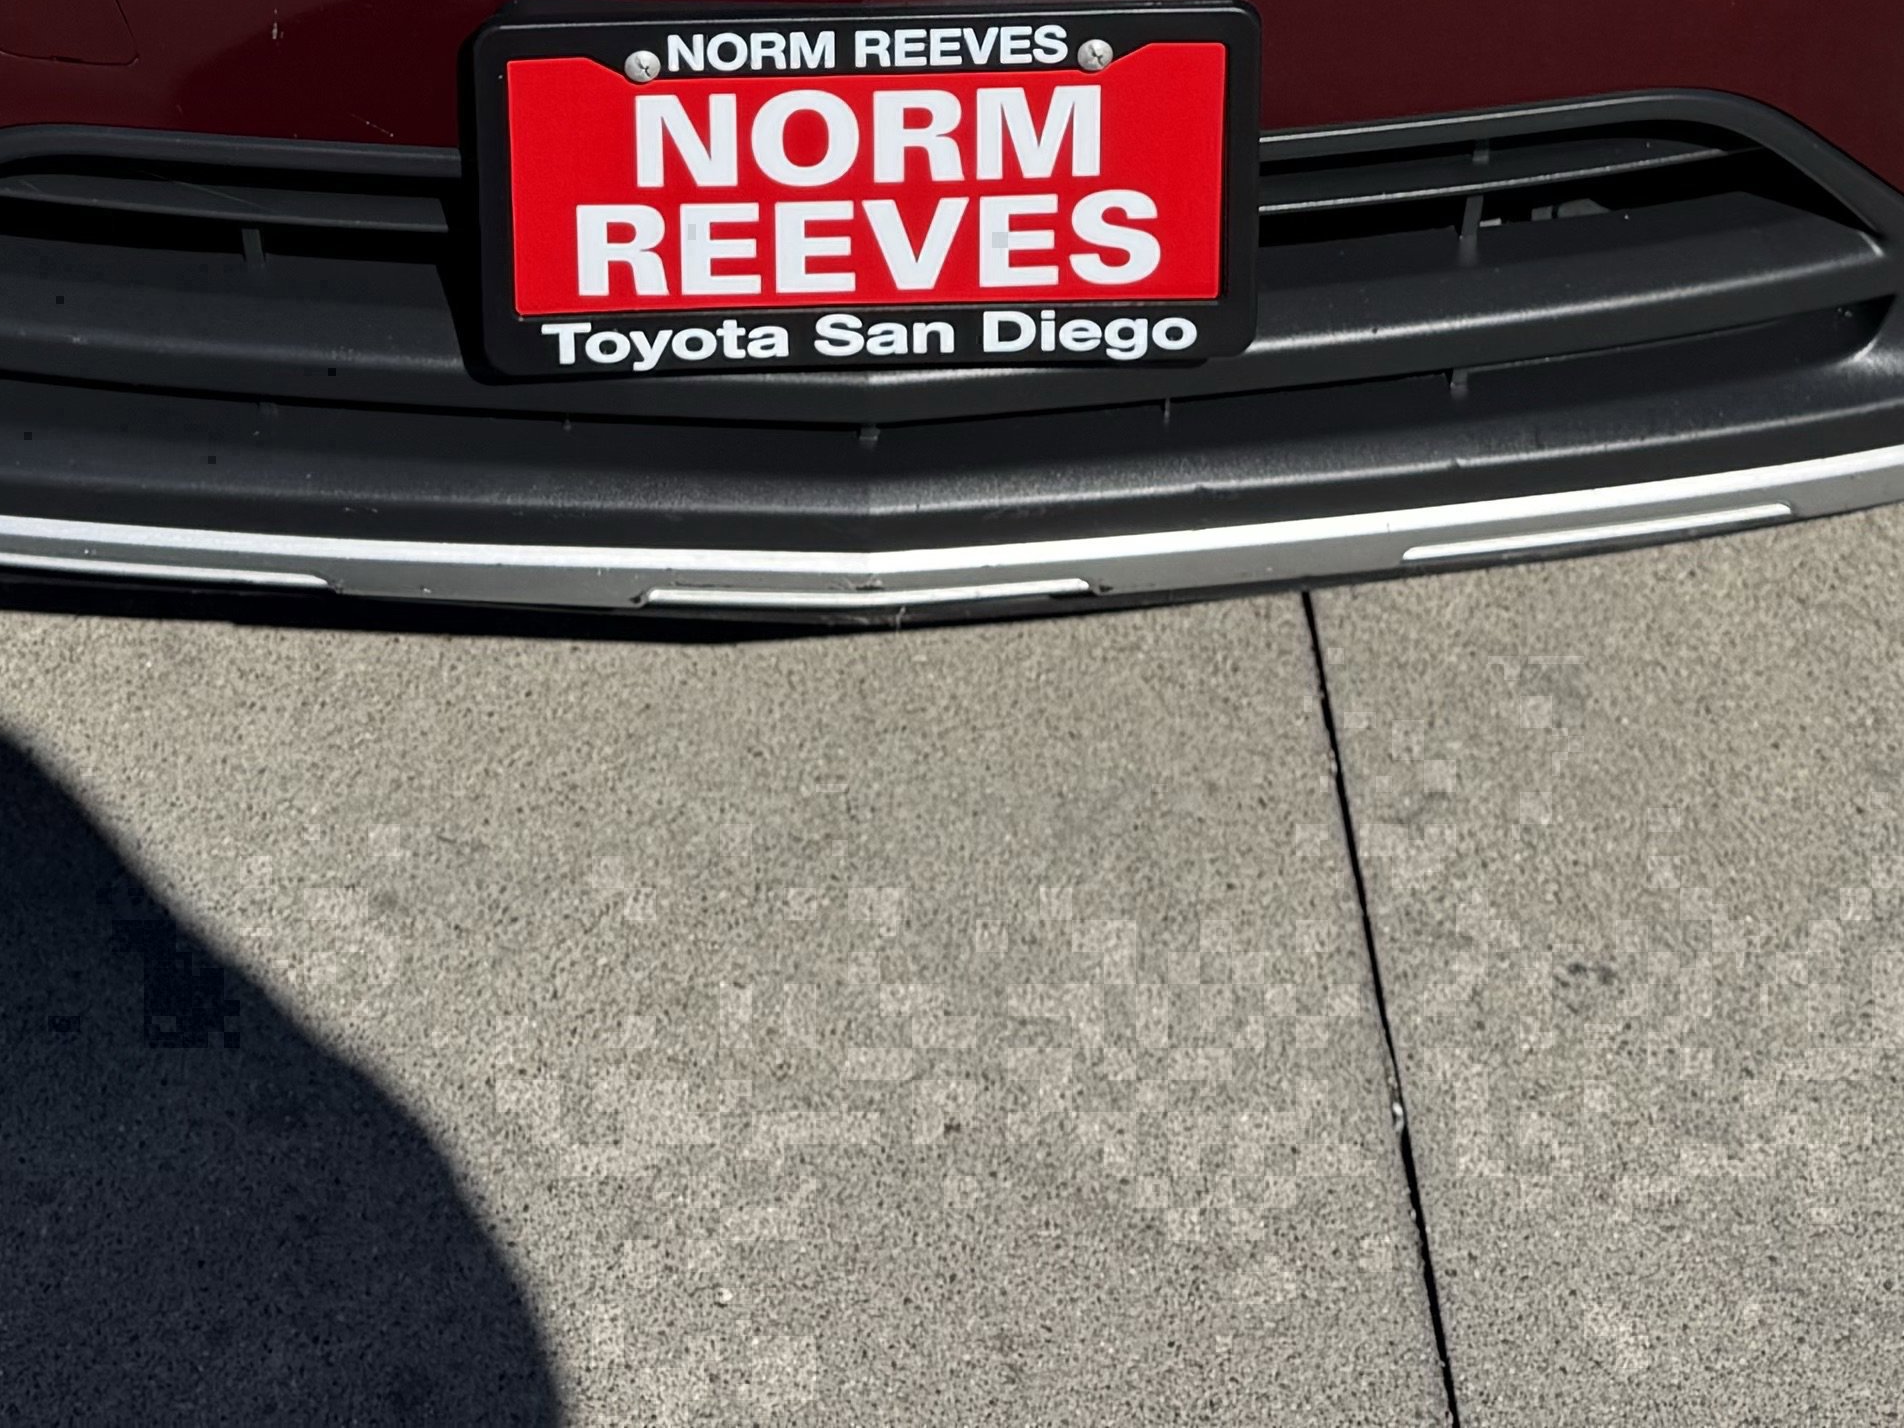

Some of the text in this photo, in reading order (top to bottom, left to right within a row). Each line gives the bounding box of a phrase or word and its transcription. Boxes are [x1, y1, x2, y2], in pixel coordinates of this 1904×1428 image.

[666, 24, 1068, 73] NORM REEVES
[635, 85, 1102, 188] NORM
[575, 188, 1162, 297] REEVES
[541, 309, 1198, 372] Toyota San Diego
